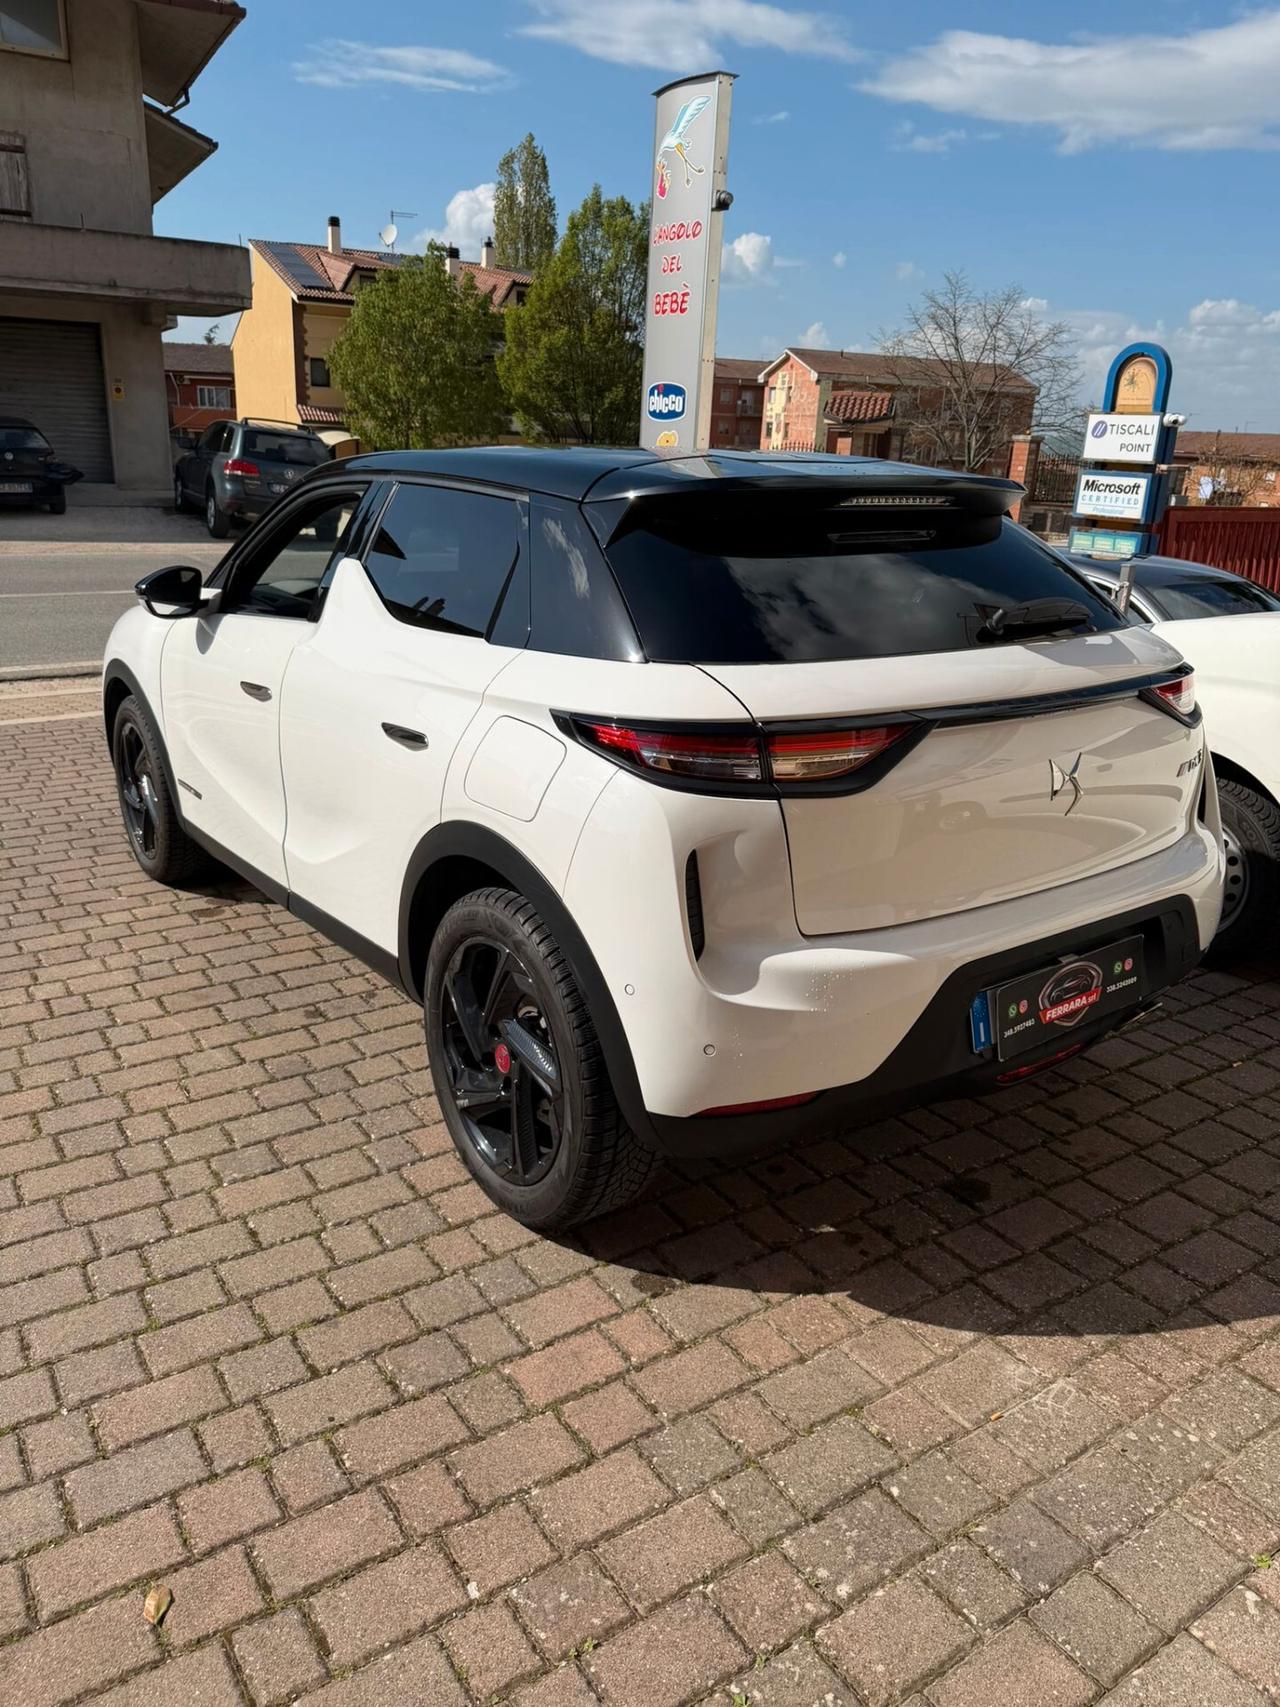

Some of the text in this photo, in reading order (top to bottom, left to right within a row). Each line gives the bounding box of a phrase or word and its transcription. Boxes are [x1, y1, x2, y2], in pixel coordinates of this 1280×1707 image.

[662, 254, 682, 274] DEL
[654, 282, 691, 315] BEBÈ
[649, 384, 685, 413] chicco
[1109, 424, 1155, 435] TISCALI
[1119, 442, 1152, 453] POINT
[1082, 478, 1141, 496] Microsoft
[1081, 495, 1139, 505] CERTIFIED
[1046, 992, 1097, 1021] FERRARA srl
